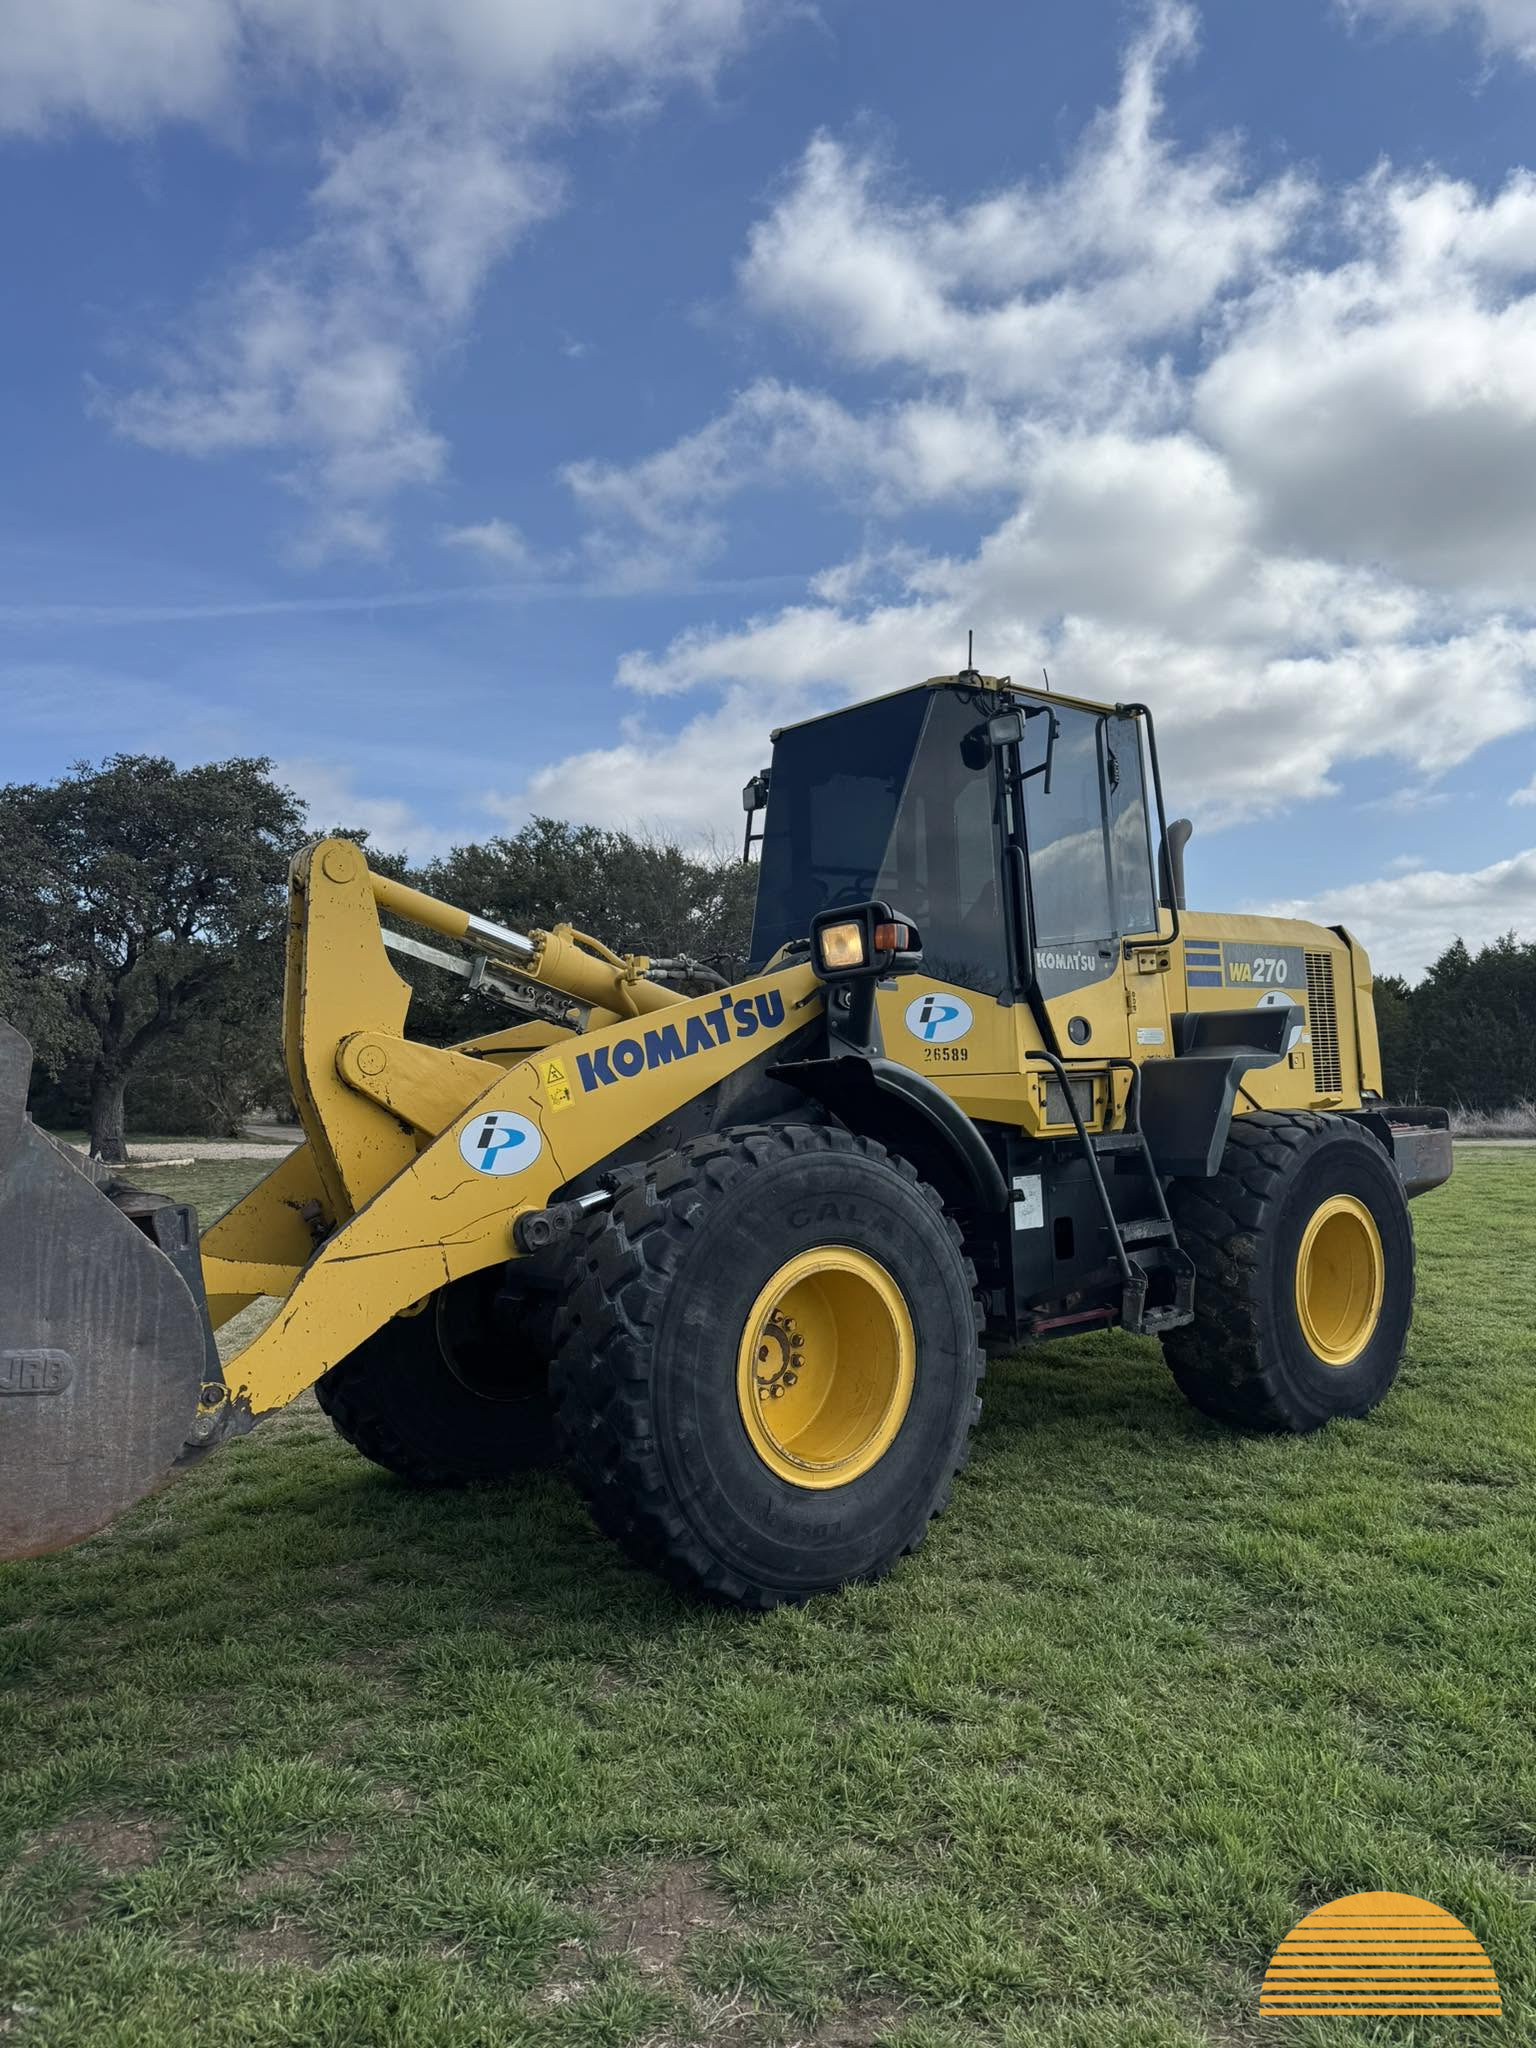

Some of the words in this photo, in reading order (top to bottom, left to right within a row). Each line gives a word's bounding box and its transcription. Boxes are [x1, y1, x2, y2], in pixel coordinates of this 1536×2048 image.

[1036, 950, 1096, 971] KOMATSU
[1229, 958, 1288, 983] WA270
[576, 989, 786, 1093] KOMATSU
[924, 1047, 968, 1062] 26589
